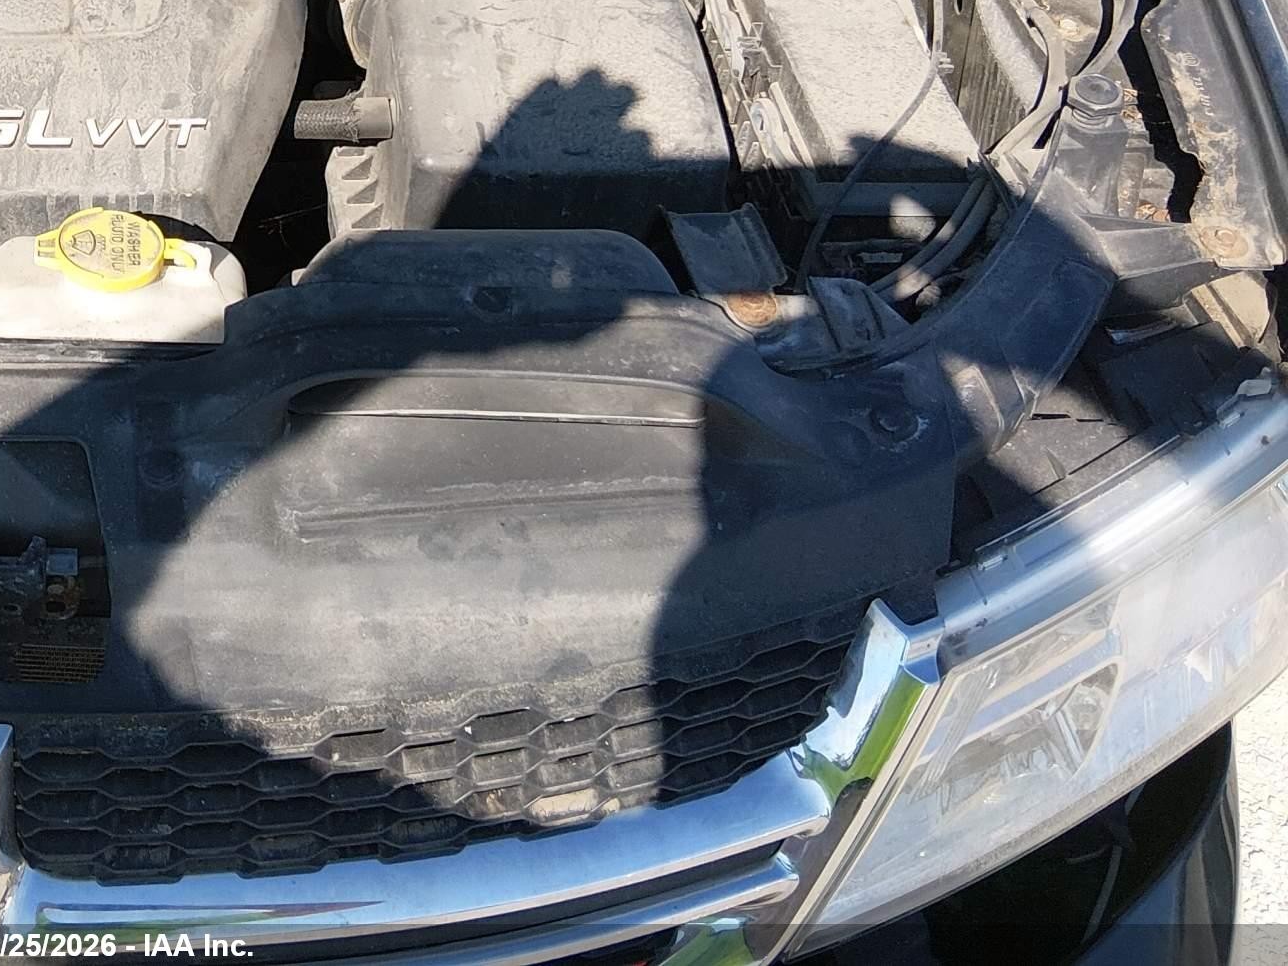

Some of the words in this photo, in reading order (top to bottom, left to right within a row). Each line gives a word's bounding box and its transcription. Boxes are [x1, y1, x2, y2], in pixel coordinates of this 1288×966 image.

[86, 118, 208, 149] VVT
[111, 214, 125, 244] FLUID
[127, 221, 142, 267] WASHER
[111, 246, 126, 274] ONLY
